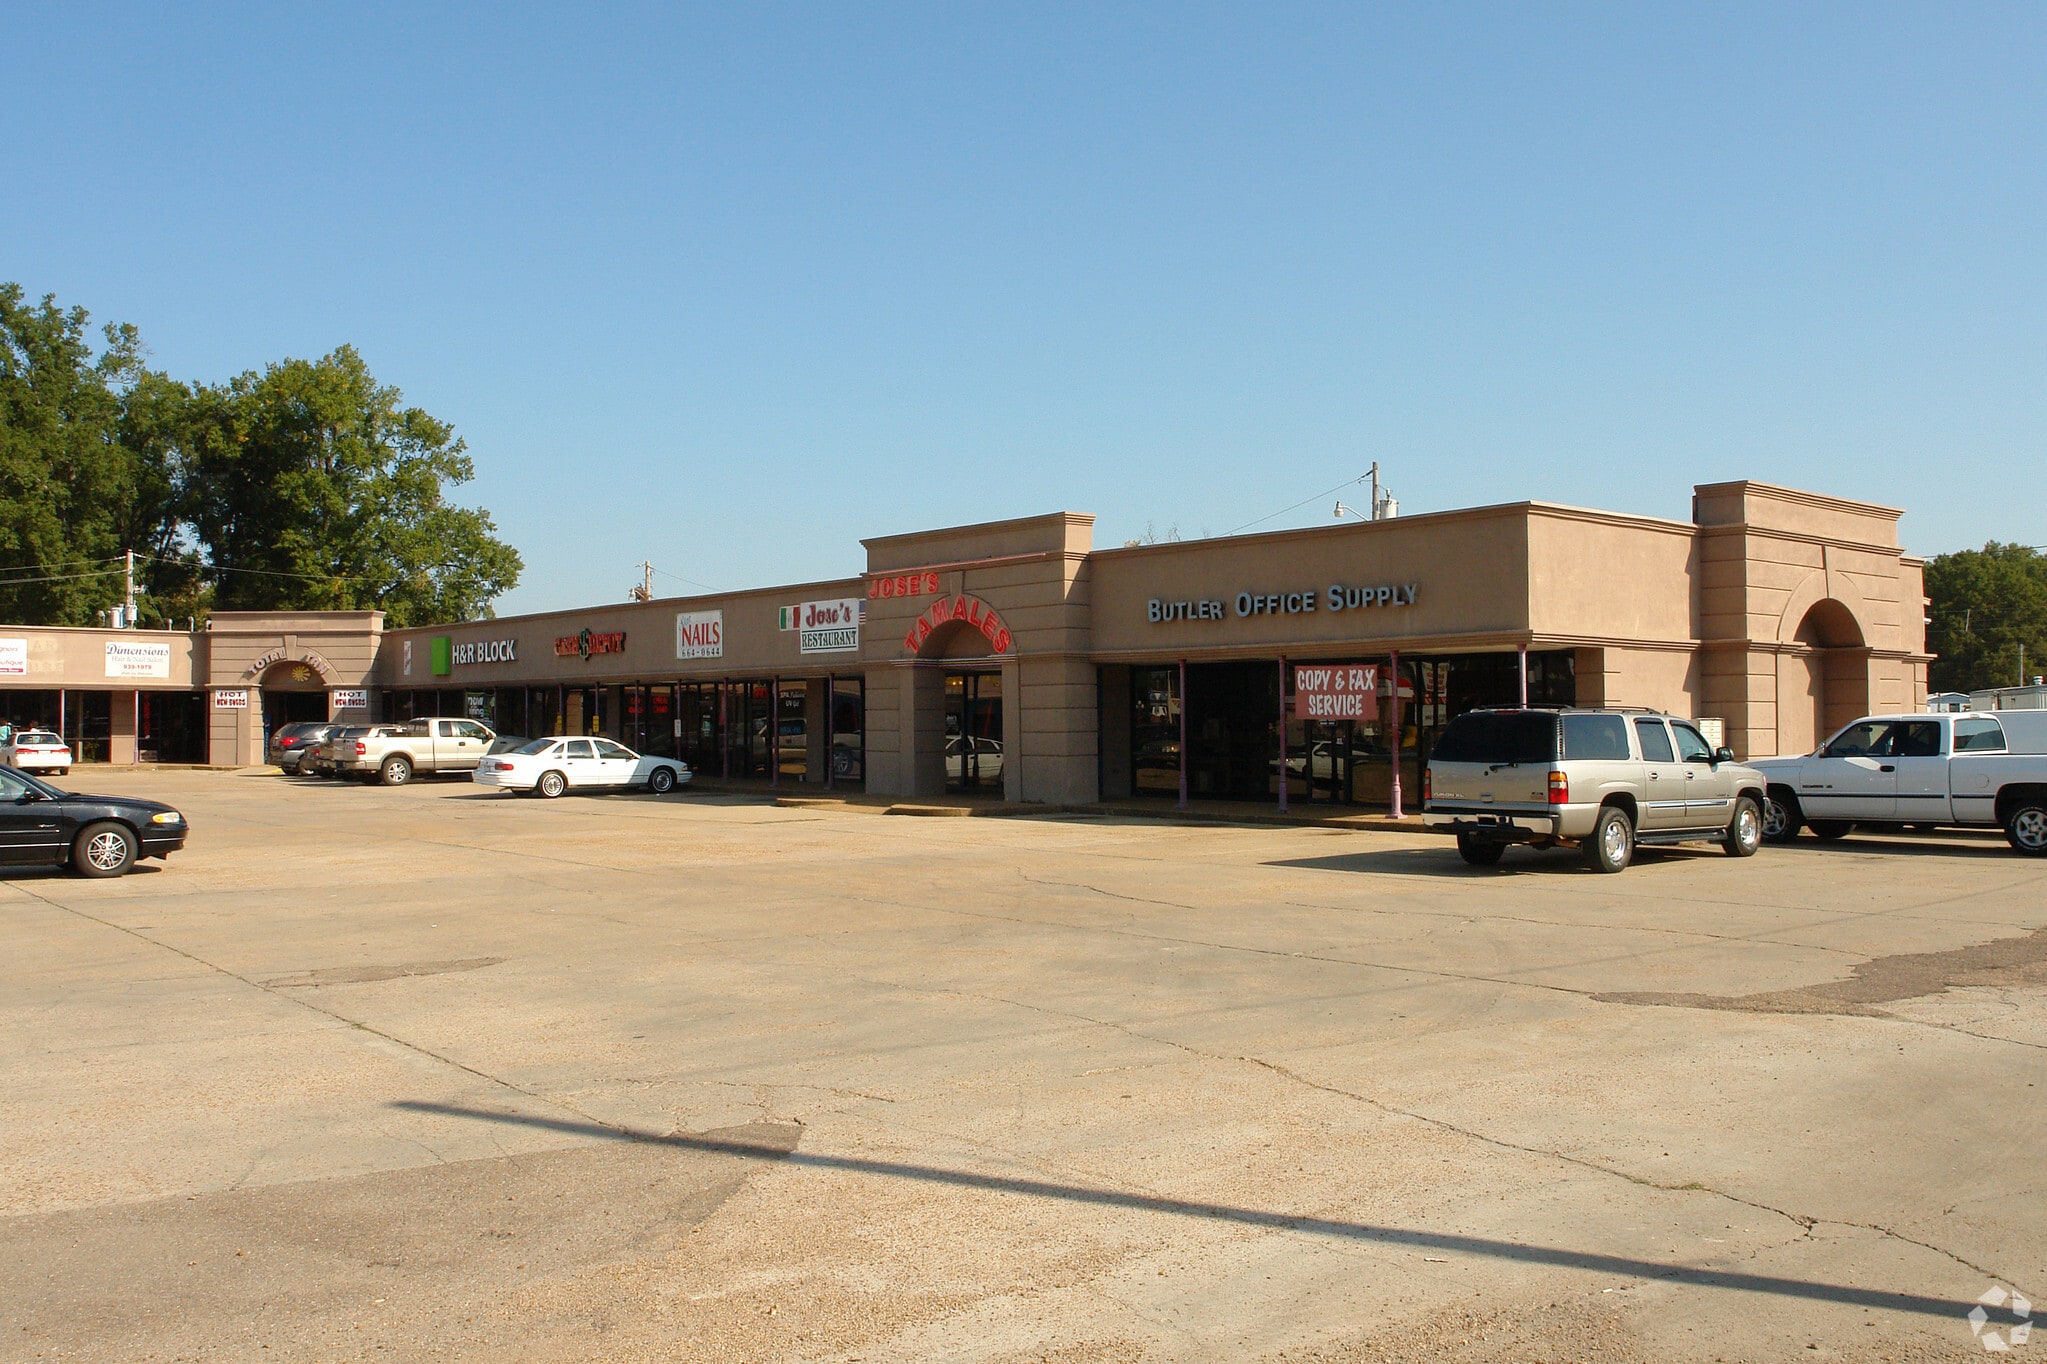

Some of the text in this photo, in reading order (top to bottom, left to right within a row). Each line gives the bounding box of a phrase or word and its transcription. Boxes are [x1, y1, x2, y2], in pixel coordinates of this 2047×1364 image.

[869, 572, 939, 599] JOSE'S
[806, 602, 852, 627] Jose's
[1148, 584, 1417, 623] BUTLER OFFICE SUPPLY
[682, 621, 720, 647] NAILS
[904, 595, 1011, 654] TAMALES
[106, 643, 169, 656] Dimensions
[452, 639, 515, 664] H&R BLOCK
[802, 630, 857, 648] RESTAURANT
[248, 647, 330, 675] TOTAL TAN
[682, 648, 720, 657] 664-0644
[1297, 669, 1375, 691] COPY & FAX
[1308, 694, 1363, 716] SERVICE
